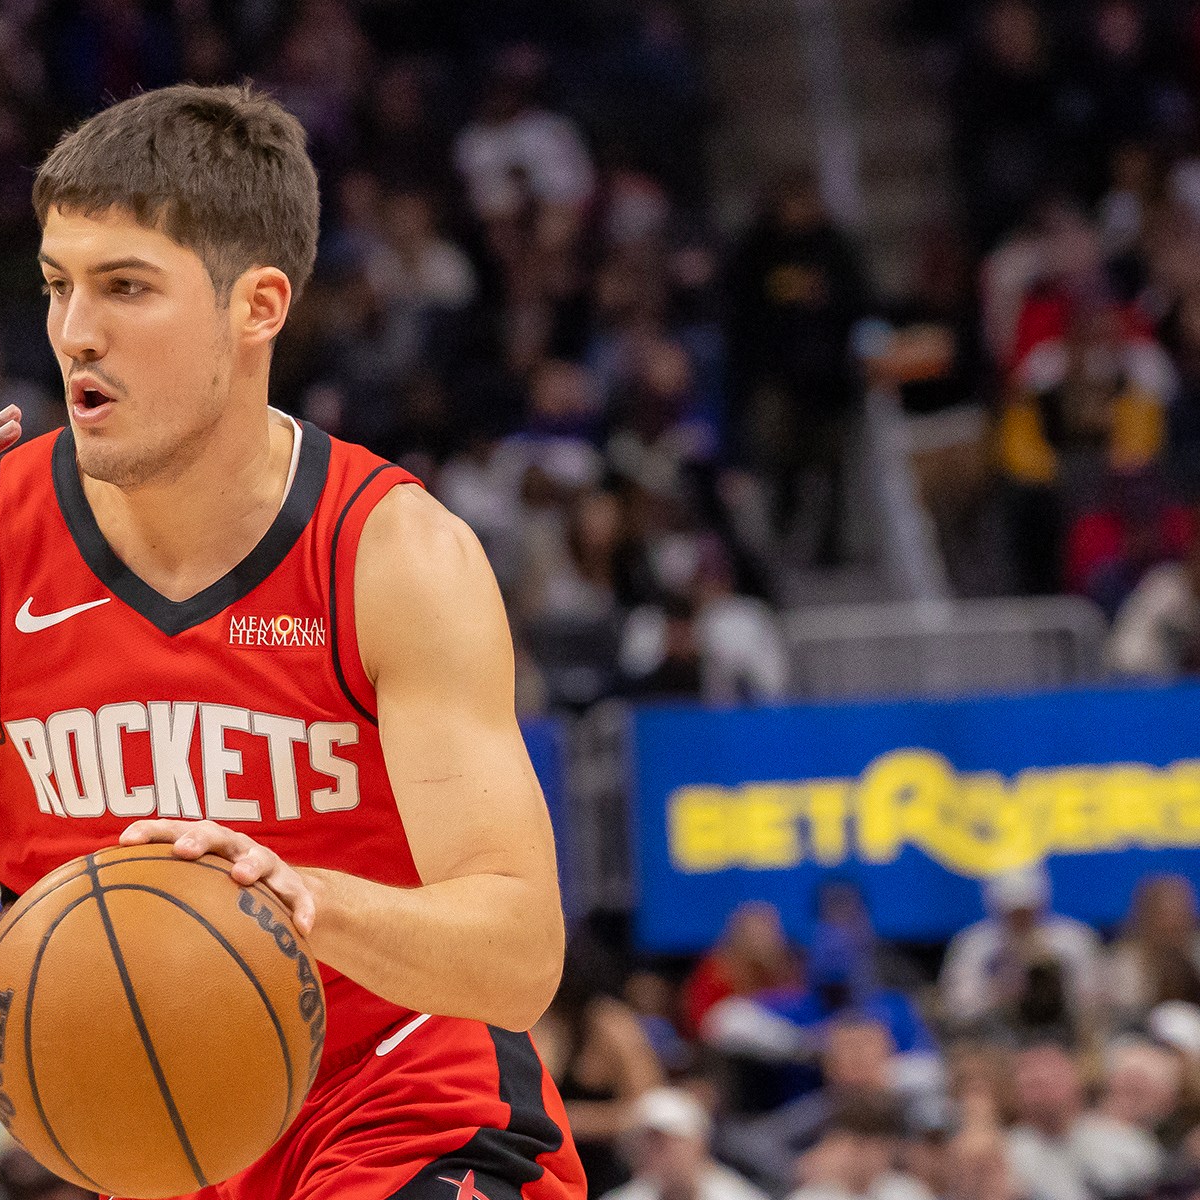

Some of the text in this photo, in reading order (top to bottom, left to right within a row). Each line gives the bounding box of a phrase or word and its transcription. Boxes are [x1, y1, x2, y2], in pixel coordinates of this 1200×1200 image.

[229, 615, 326, 633] MEMORIAL
[229, 629, 325, 646] HERMANN
[4, 701, 360, 822] ROCKETS
